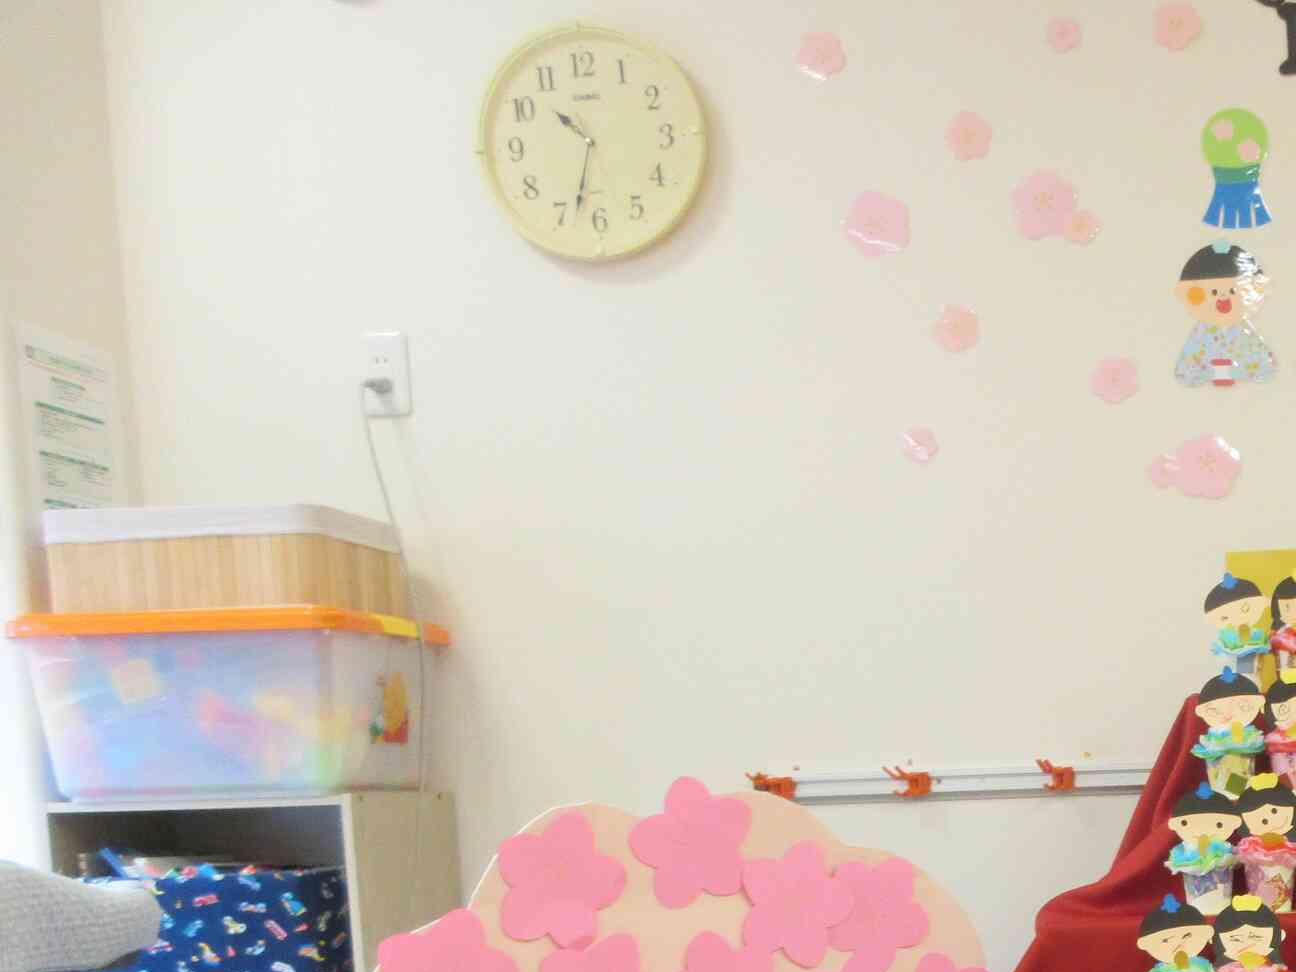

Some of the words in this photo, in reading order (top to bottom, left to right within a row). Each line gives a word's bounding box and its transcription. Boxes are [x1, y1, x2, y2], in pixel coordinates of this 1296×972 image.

[571, 51, 595, 77] 12
[617, 59, 627, 84] 1
[537, 66, 556, 92] 11
[513, 96, 535, 122] 10
[645, 84, 661, 110] 2
[659, 123, 674, 149] 3
[508, 137, 524, 162] 9
[649, 163, 665, 187] 4
[523, 176, 539, 200] 8
[553, 202, 567, 226] 7
[592, 208, 608, 232] 6
[629, 196, 645, 220] 5
